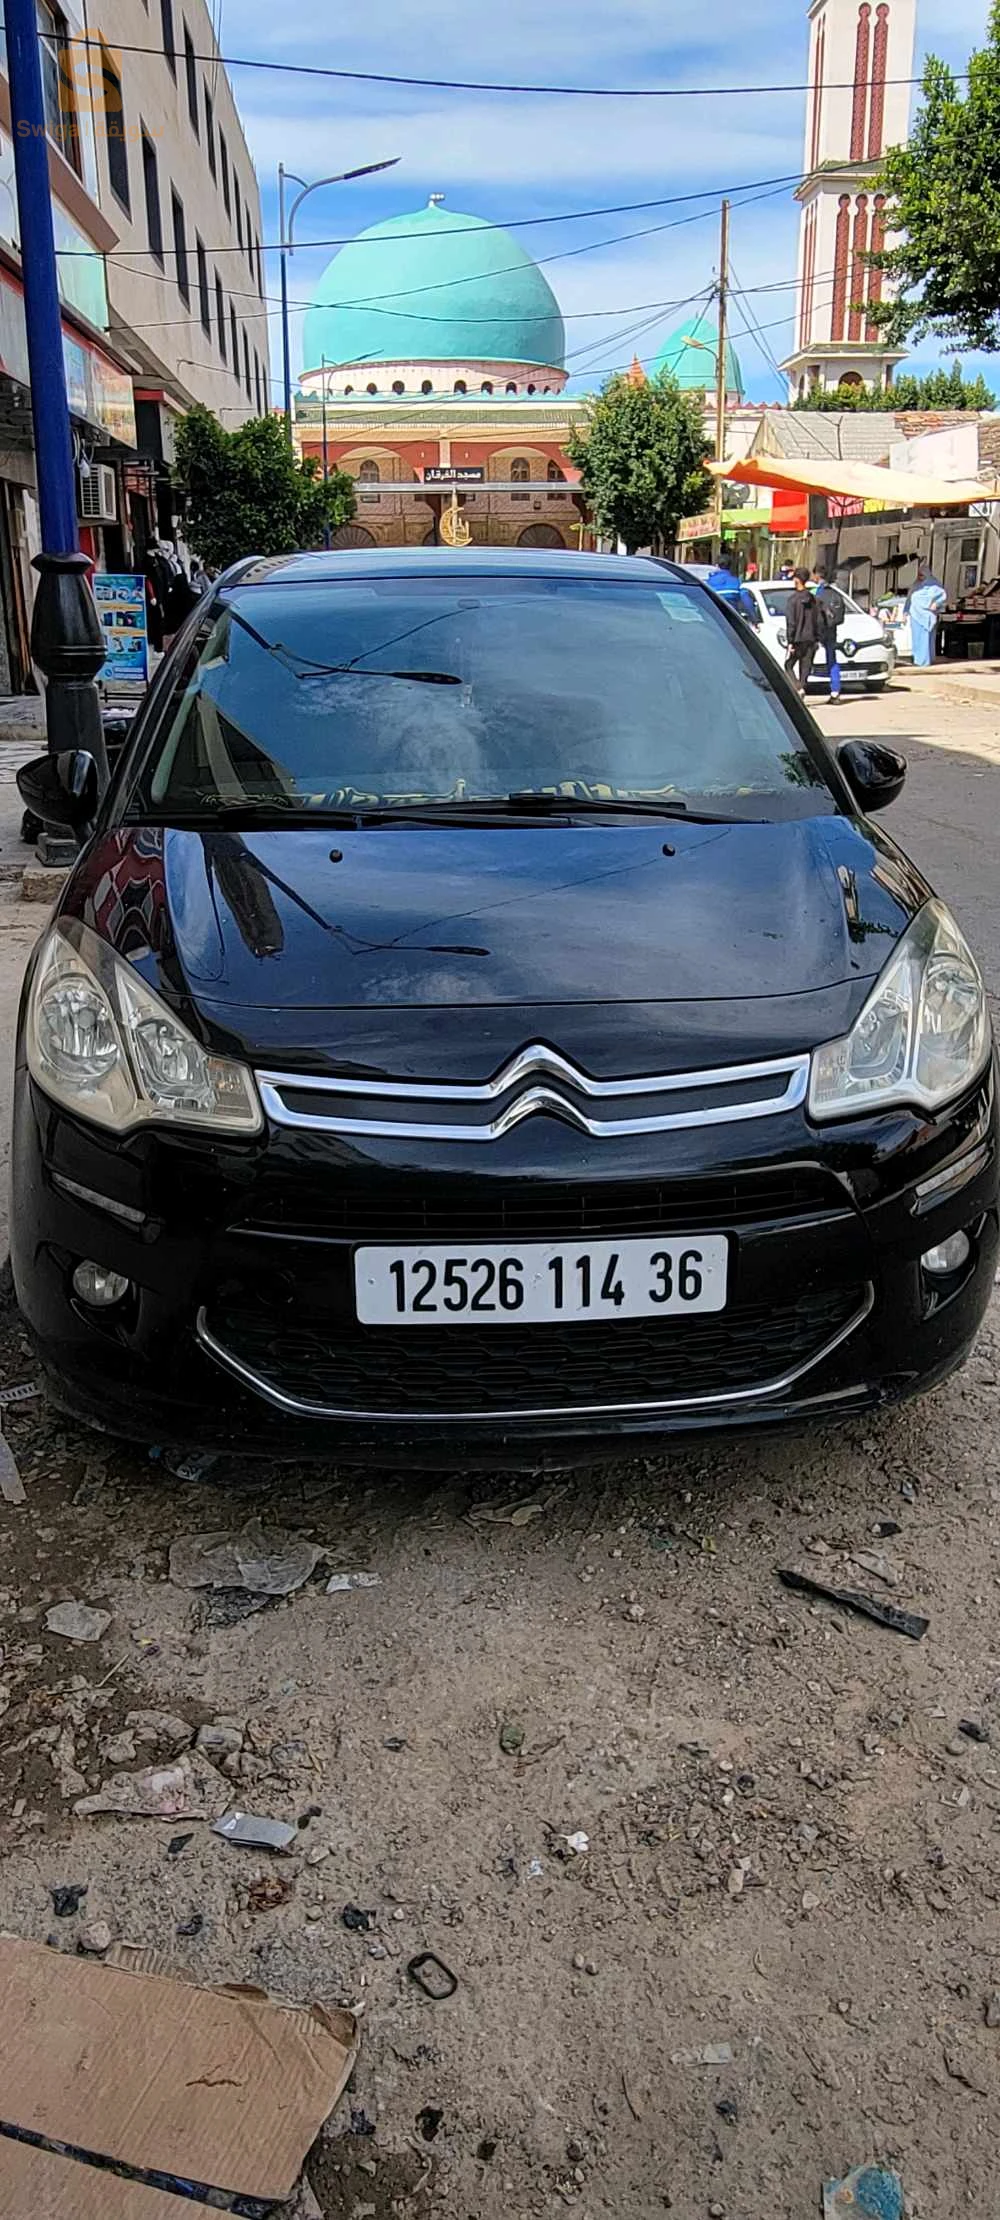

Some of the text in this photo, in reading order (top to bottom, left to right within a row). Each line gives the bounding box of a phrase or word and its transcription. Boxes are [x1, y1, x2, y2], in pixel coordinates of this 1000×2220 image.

[425, 469, 481, 481] مسجد الفرقان
[389, 1249, 704, 1313] 12526 114 36
